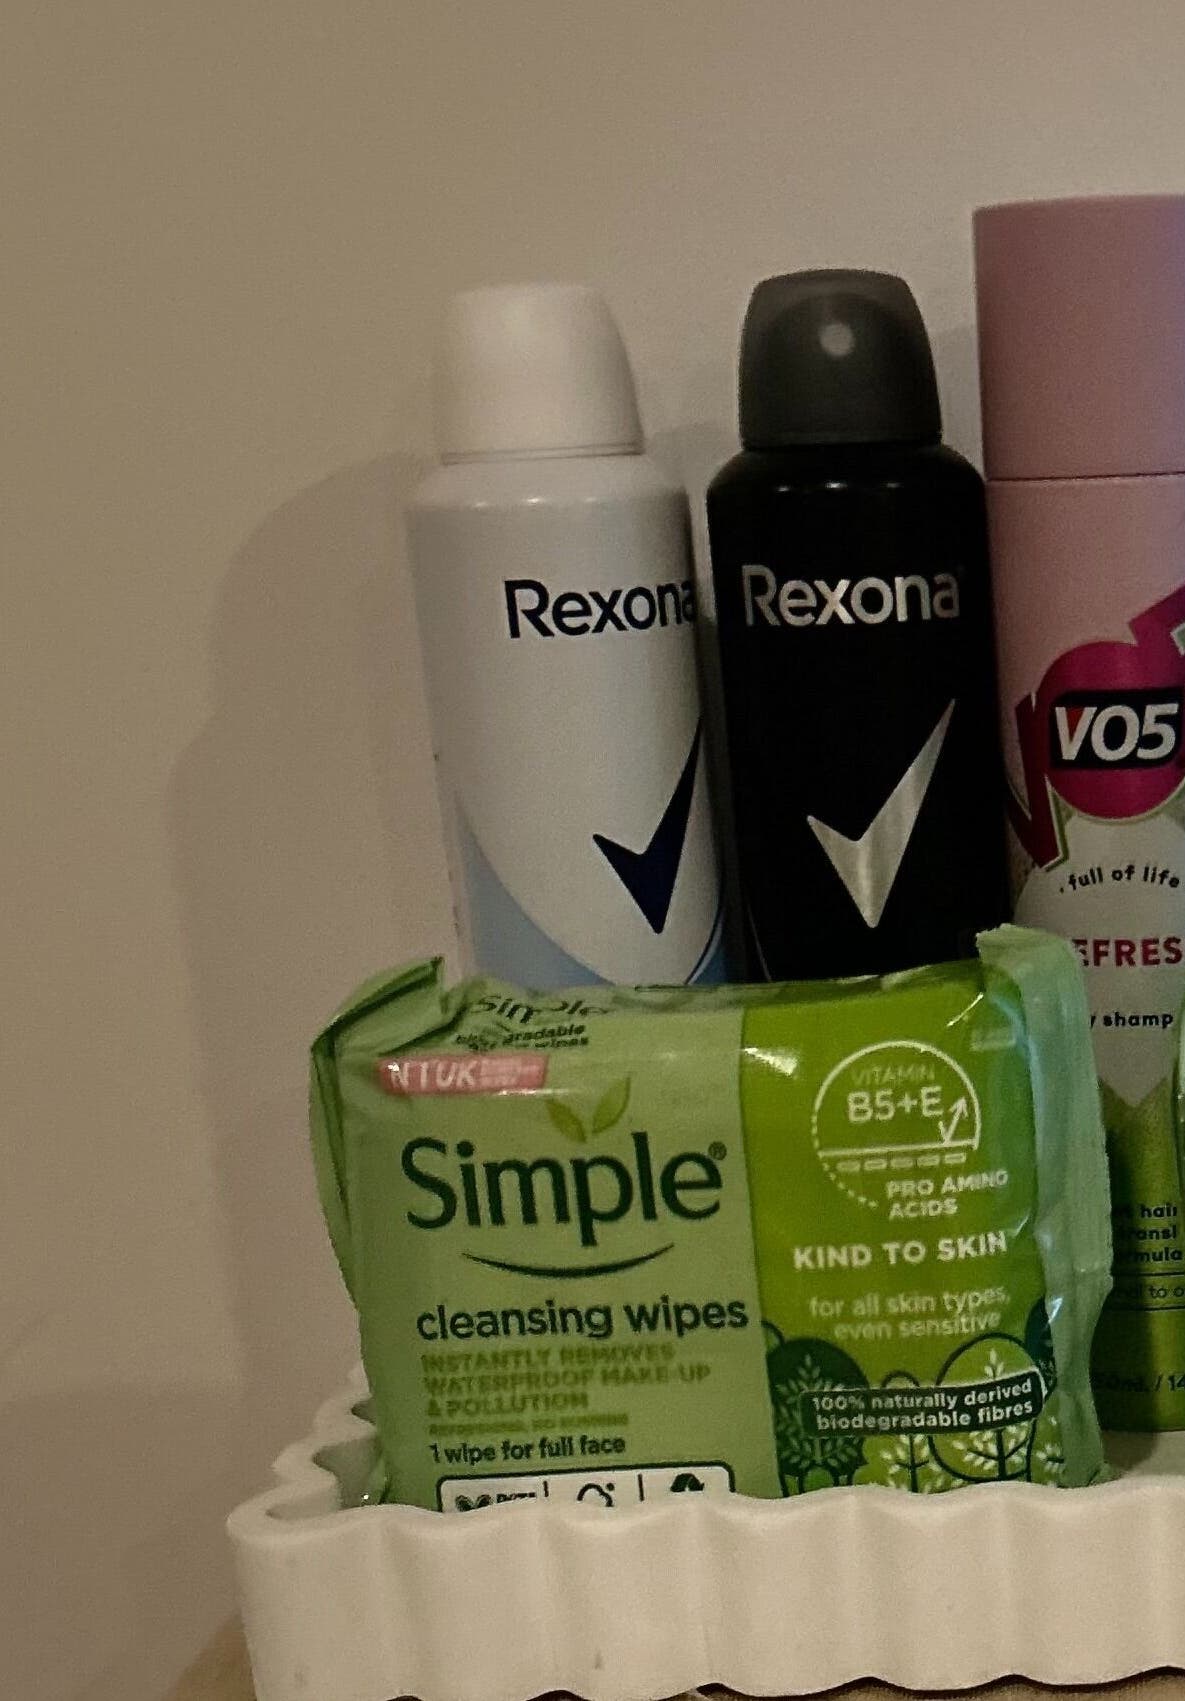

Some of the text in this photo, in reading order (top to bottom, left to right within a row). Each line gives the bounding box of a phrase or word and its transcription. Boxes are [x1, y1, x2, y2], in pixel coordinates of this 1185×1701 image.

[742, 564, 960, 627] Rexona
[1055, 702, 1179, 762] VO5
[1068, 867, 1103, 891] full
[1111, 864, 1135, 882] of
[1103, 1012, 1174, 1029] shamp
[848, 1086, 944, 1122] B5+E
[886, 1170, 1009, 1198] PRO AMINO
[889, 1198, 958, 1220] ACIDS
[793, 1230, 1008, 1270] KIND TO SKIN
[416, 1295, 750, 1341] cleansing wipes
[809, 1296, 844, 1317] for
[853, 1293, 880, 1316] all
[885, 1289, 937, 1314] skin
[834, 1311, 1001, 1340] even sensitive
[421, 1342, 674, 1374] INSTANTLY REMOVES
[424, 1367, 594, 1397] WATERPROOF
[813, 1378, 1033, 1412] 100% naturally derived
[447, 1391, 589, 1415] POLLUTION
[816, 1400, 1034, 1431] biodegradable fibres
[430, 1434, 626, 1466] 1 wipe for full face
